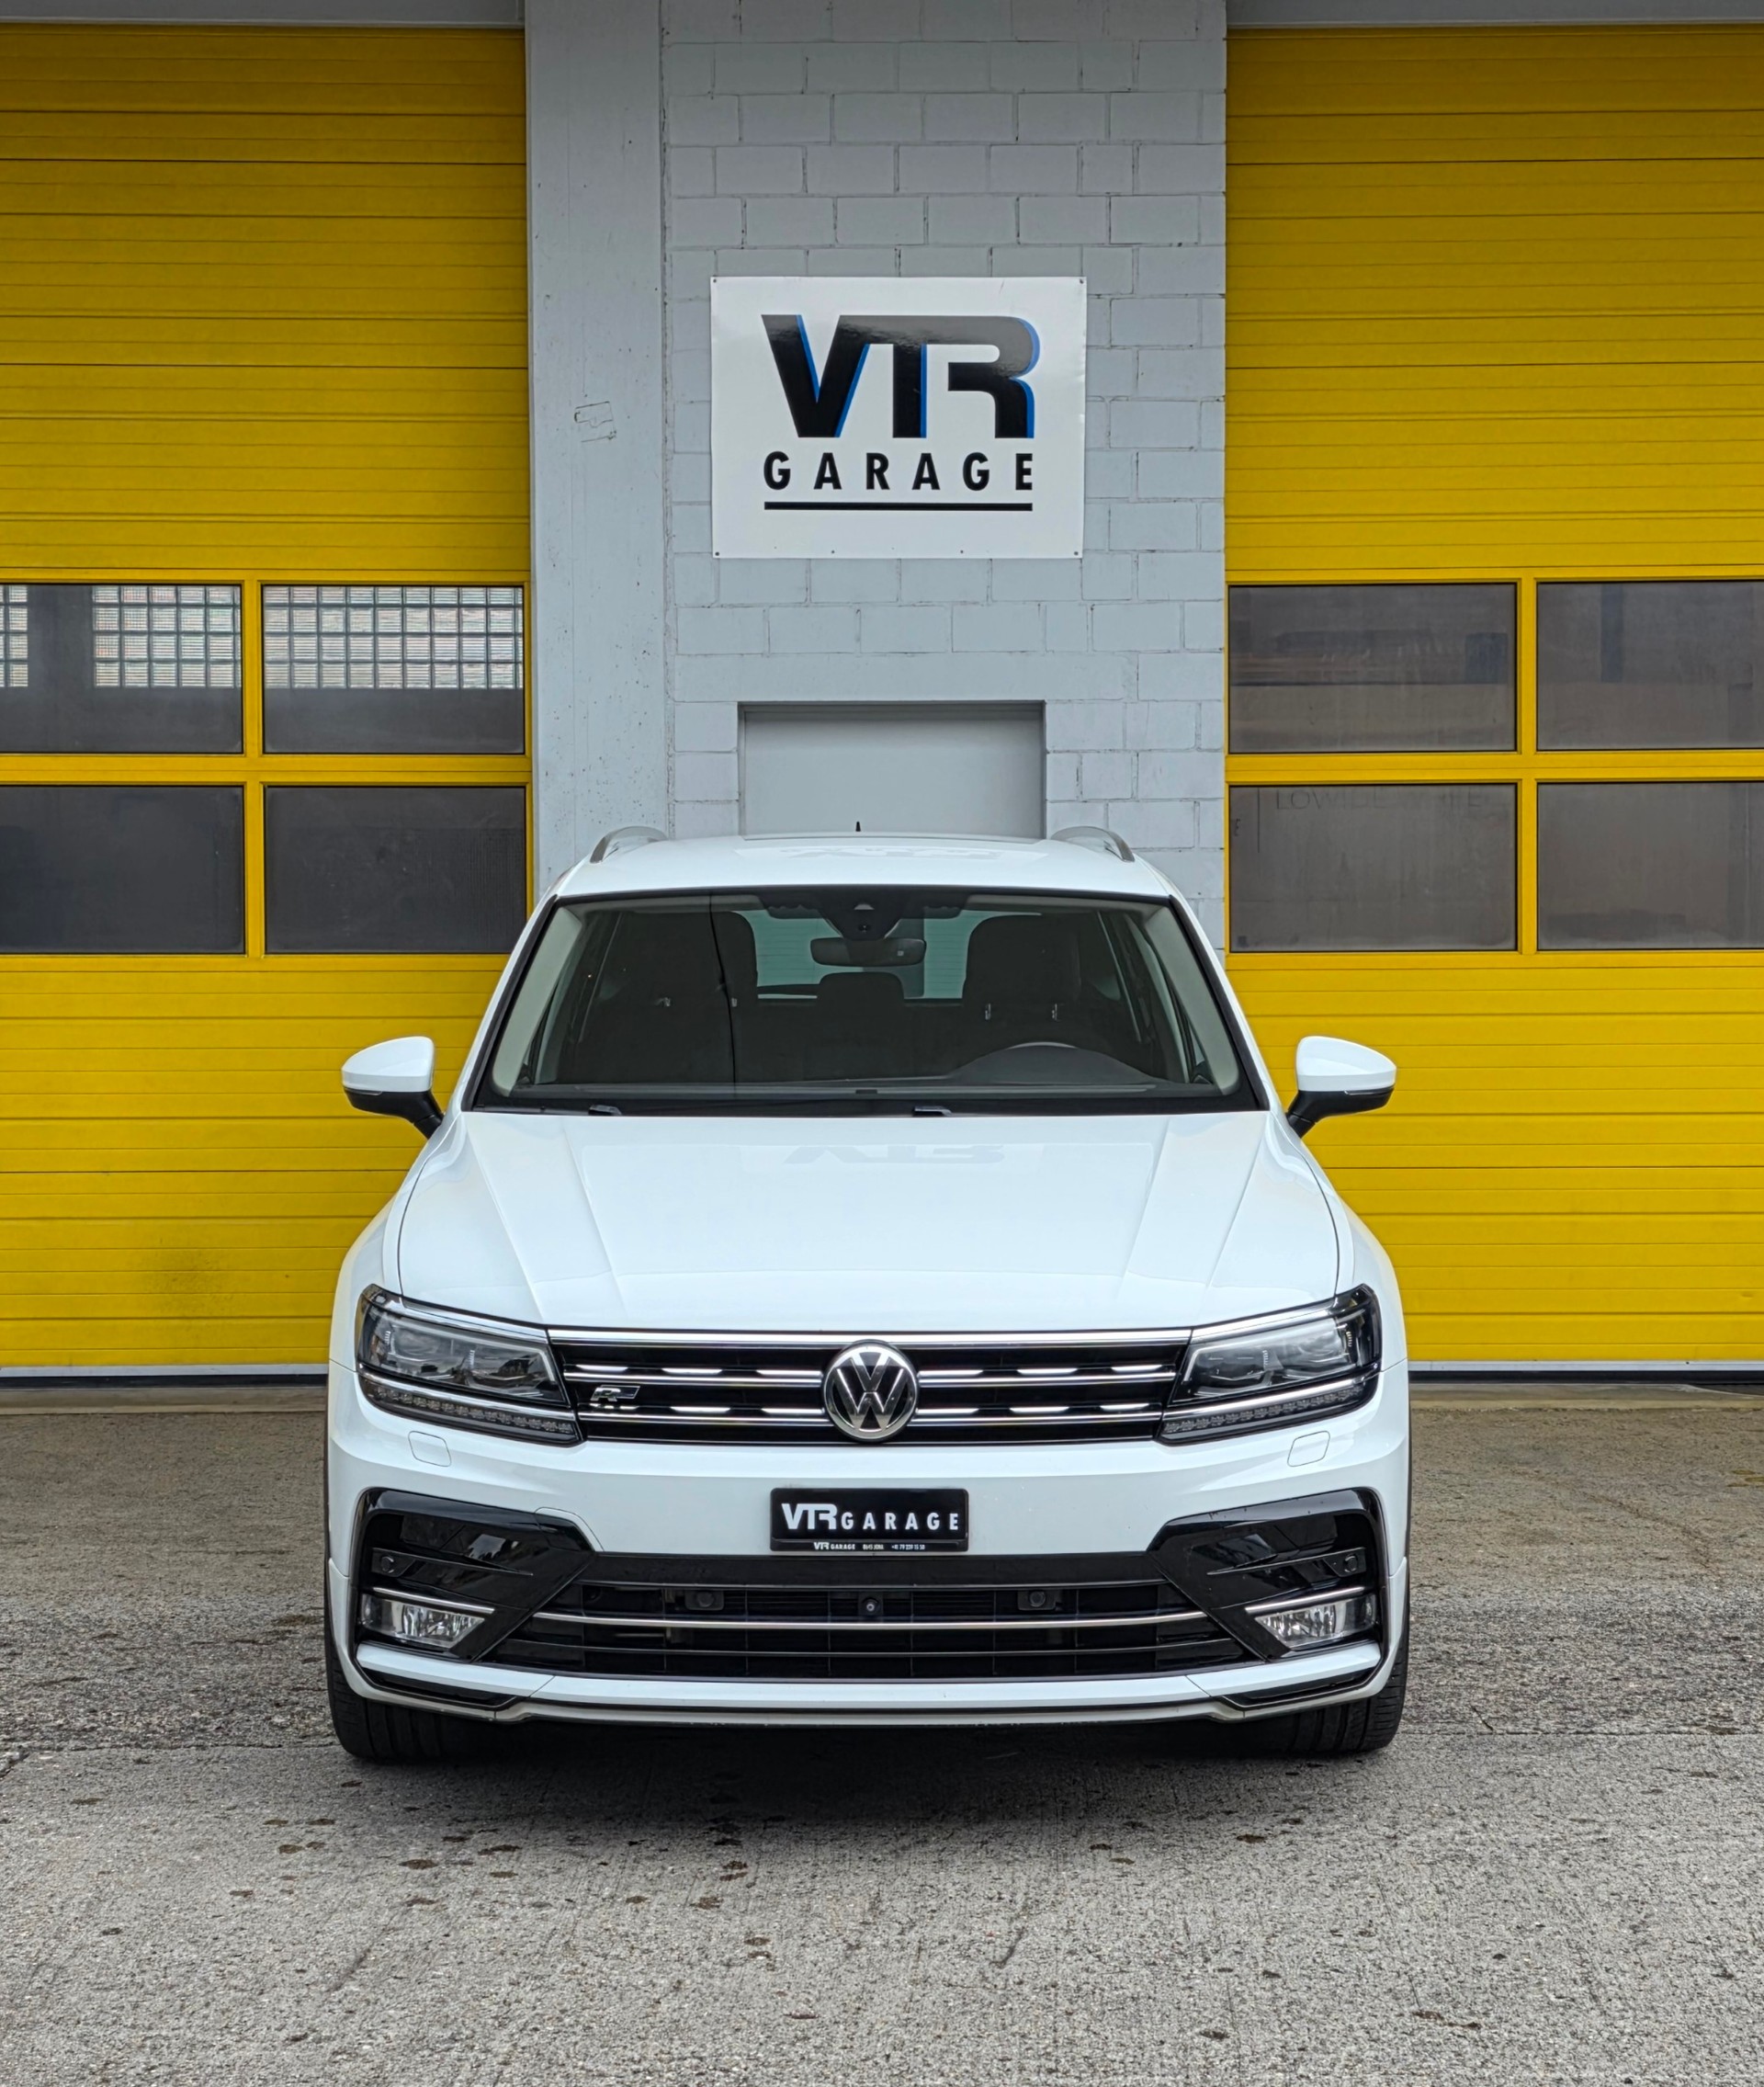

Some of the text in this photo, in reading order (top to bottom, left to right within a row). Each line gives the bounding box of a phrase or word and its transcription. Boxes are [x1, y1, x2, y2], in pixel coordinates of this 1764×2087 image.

[761, 314, 1040, 438] VTR
[763, 450, 1034, 492] GARAGE
[781, 1503, 958, 1531] VTR GARAGE
[813, 1542, 830, 1550] VTR
